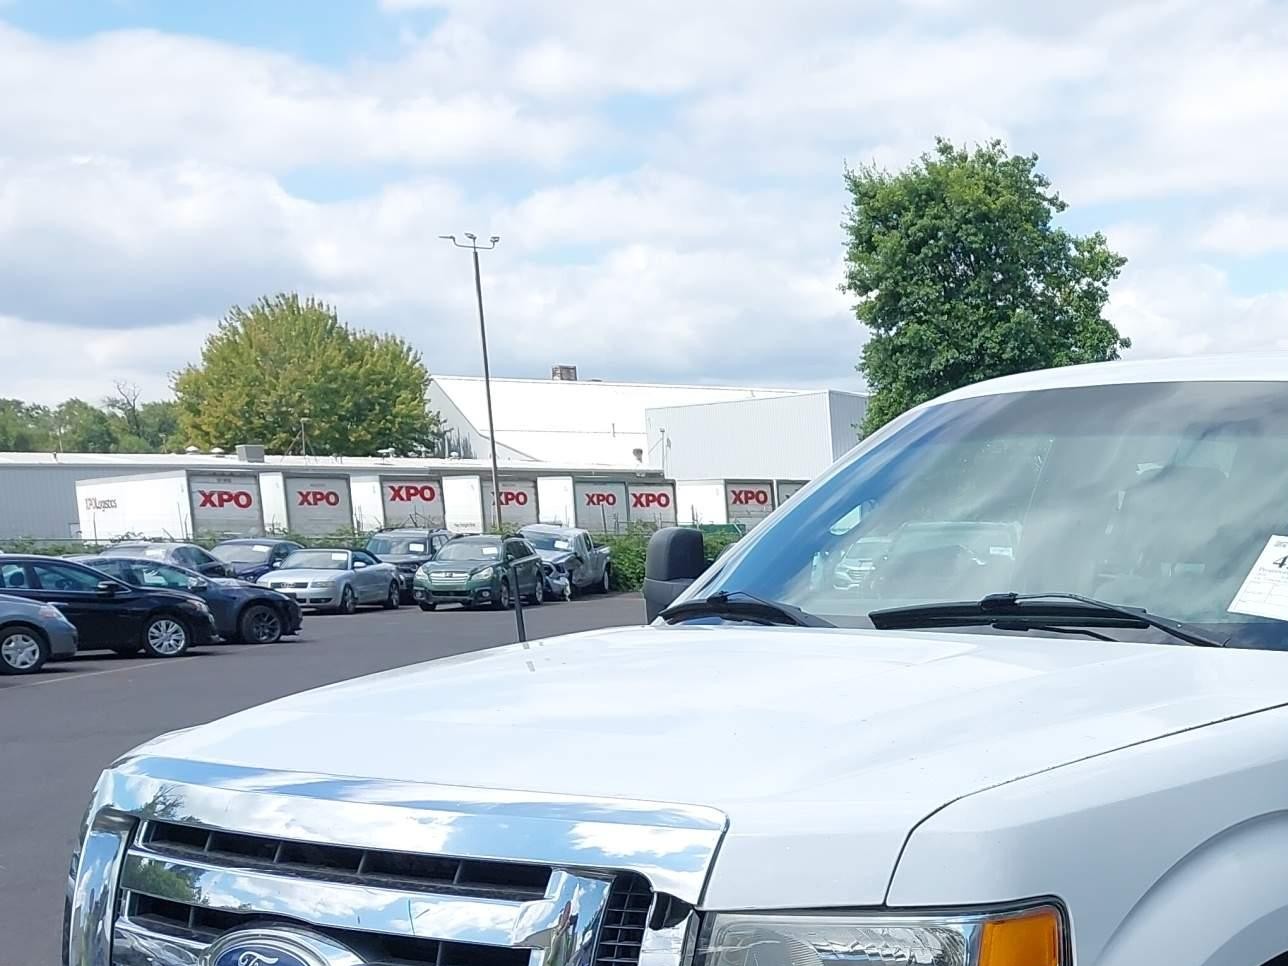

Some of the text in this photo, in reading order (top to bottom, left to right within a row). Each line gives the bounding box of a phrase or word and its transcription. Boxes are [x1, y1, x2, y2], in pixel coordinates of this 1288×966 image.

[199, 489, 253, 508] XPO
[297, 491, 340, 506] XPO
[389, 485, 436, 502] XPO
[585, 493, 617, 506] XPO
[631, 493, 670, 507] XPO
[731, 489, 768, 505] XPO
